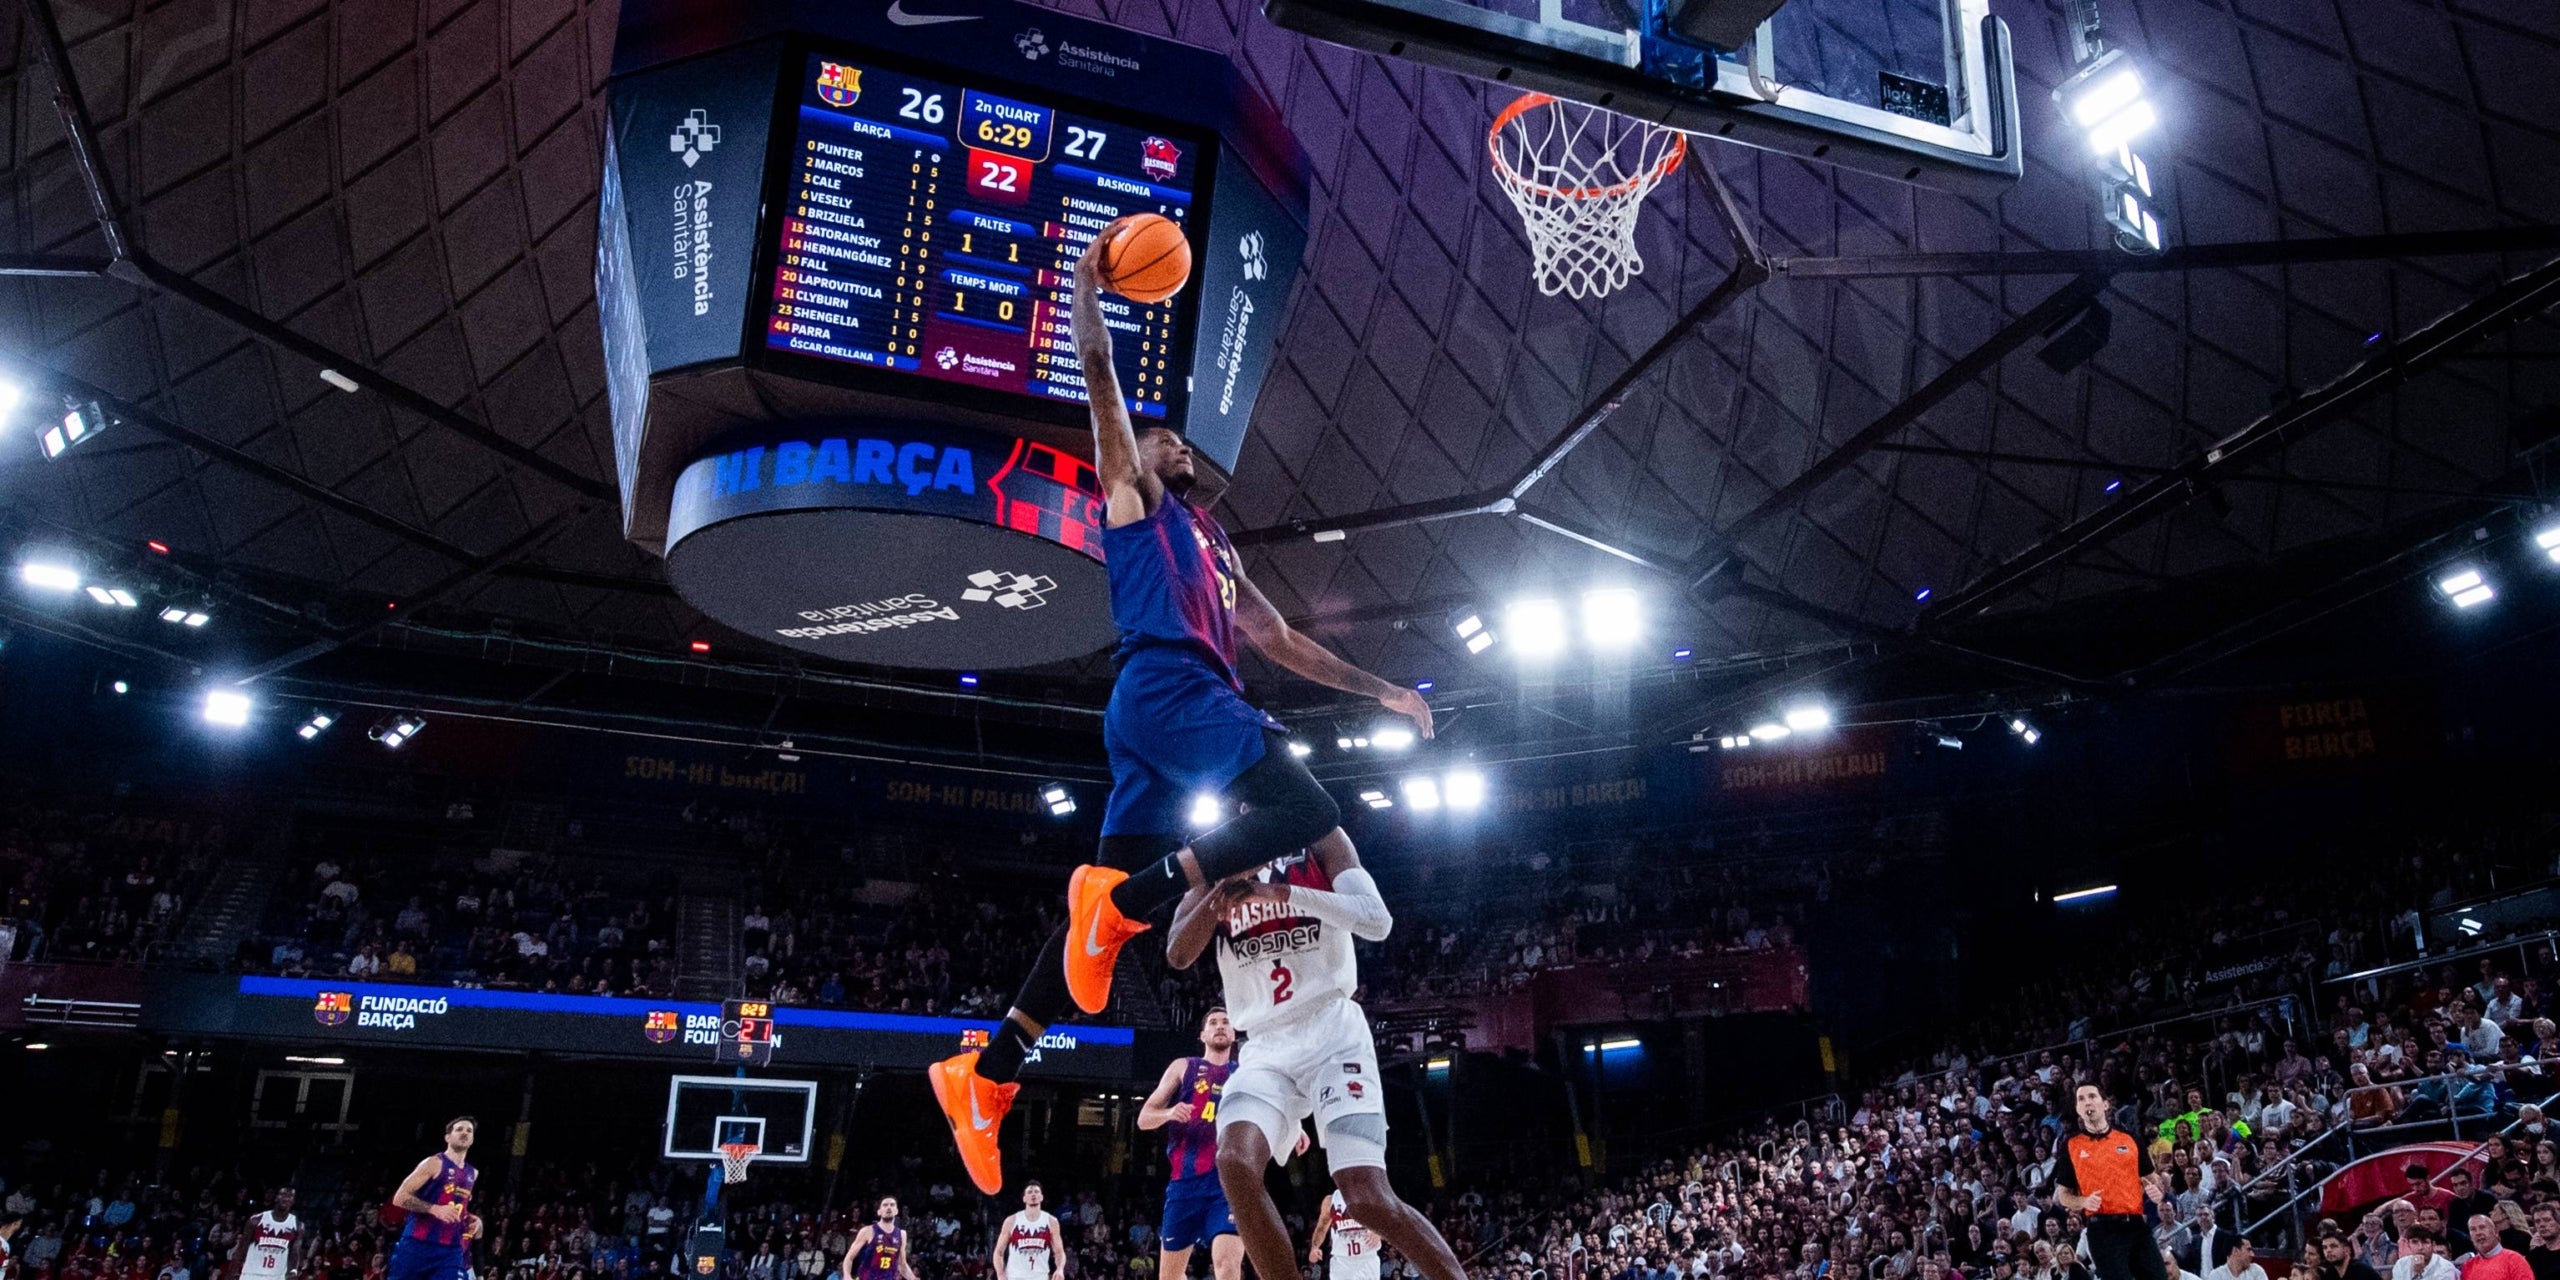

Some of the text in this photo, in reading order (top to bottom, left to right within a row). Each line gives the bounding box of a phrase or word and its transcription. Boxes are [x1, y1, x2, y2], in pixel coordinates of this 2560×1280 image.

[1058, 53, 1115, 77] Sanitària
[1059, 40, 1140, 70] Assistència
[900, 88, 944, 124] 26
[975, 99, 1040, 124] 2n QUART
[853, 121, 892, 140] BARÇA
[978, 119, 1032, 148] 6:29
[1064, 126, 1106, 160] 27
[807, 140, 938, 178] 0 PUNTER 0 5
[914, 150, 922, 160] F
[806, 157, 936, 194] 2 MARCOS 1 2
[980, 162, 1018, 192] 22
[1097, 176, 1150, 197] BASKONIA
[803, 173, 934, 210] 3 CALE 1 0
[1062, 196, 1118, 217] 0 HOWARD
[801, 190, 932, 226] 6 VESELY 1 5
[1062, 213, 1067, 222] 1
[1160, 205, 1167, 214] F
[674, 184, 692, 279] Sanitària
[798, 206, 930, 242] 8 BRIZUELA 0 0
[974, 216, 1011, 233] FALTES
[1058, 228, 1098, 243] 2 SIMM
[694, 180, 714, 316] Assistència
[792, 222, 928, 258] 13 SATORANSKY 0 0
[961, 234, 1019, 262] 1 1
[1056, 244, 1084, 257] 4 VIL
[788, 238, 925, 274] 14 HERNANGÓMEZ 1 9
[1055, 260, 1061, 269] 6
[786, 254, 924, 290] 19 FALL 0 0
[951, 273, 1020, 295] TEMPS MORT
[1053, 275, 1060, 284] 7
[782, 270, 921, 306] 20 LAPROVITTOLA 1 0
[782, 287, 919, 322] 21 CLYBURN 1 5
[954, 292, 1014, 320] 1 0
[1050, 292, 1057, 300] 8
[1146, 311, 1153, 320] 0
[1163, 314, 1169, 323] 3
[778, 304, 917, 338] 23 SHENGELIA 1 0
[1049, 307, 1055, 315] 9
[1146, 327, 1150, 335] 1
[1161, 330, 1168, 338] 5
[1218, 285, 1244, 370] Sanitària
[774, 320, 915, 355] 44 PARRA 0 0
[790, 335, 894, 366] ÓSCAR ORELLANA 0
[1042, 322, 1053, 332] 10
[1143, 342, 1149, 350] 0
[1160, 345, 1166, 354] 2
[963, 353, 1015, 372] Assistència
[1039, 337, 1165, 370] 18 DIO 0 0
[1219, 294, 1254, 416] Assistència
[962, 363, 1000, 378] Sanitària
[1037, 354, 1163, 385] 25 FRISC 0 0
[1036, 369, 1048, 379] 77
[1137, 389, 1144, 397] 0
[1154, 392, 1161, 401] 0
[1048, 386, 1142, 411] PAOLO GA 0
[774, 438, 976, 496] BARÇA
[777, 605, 961, 639] Assistència
[798, 594, 940, 621] Sanitària
[625, 756, 713, 785] SOM-HI
[1270, 966, 1294, 1006] 2
[361, 996, 448, 1014] FUNDACIÓ
[358, 1012, 415, 1030] BARÇA
[686, 1014, 720, 1029] BAR
[1034, 1032, 1076, 1050] ACIÓN
[1201, 1101, 1216, 1123] 4
